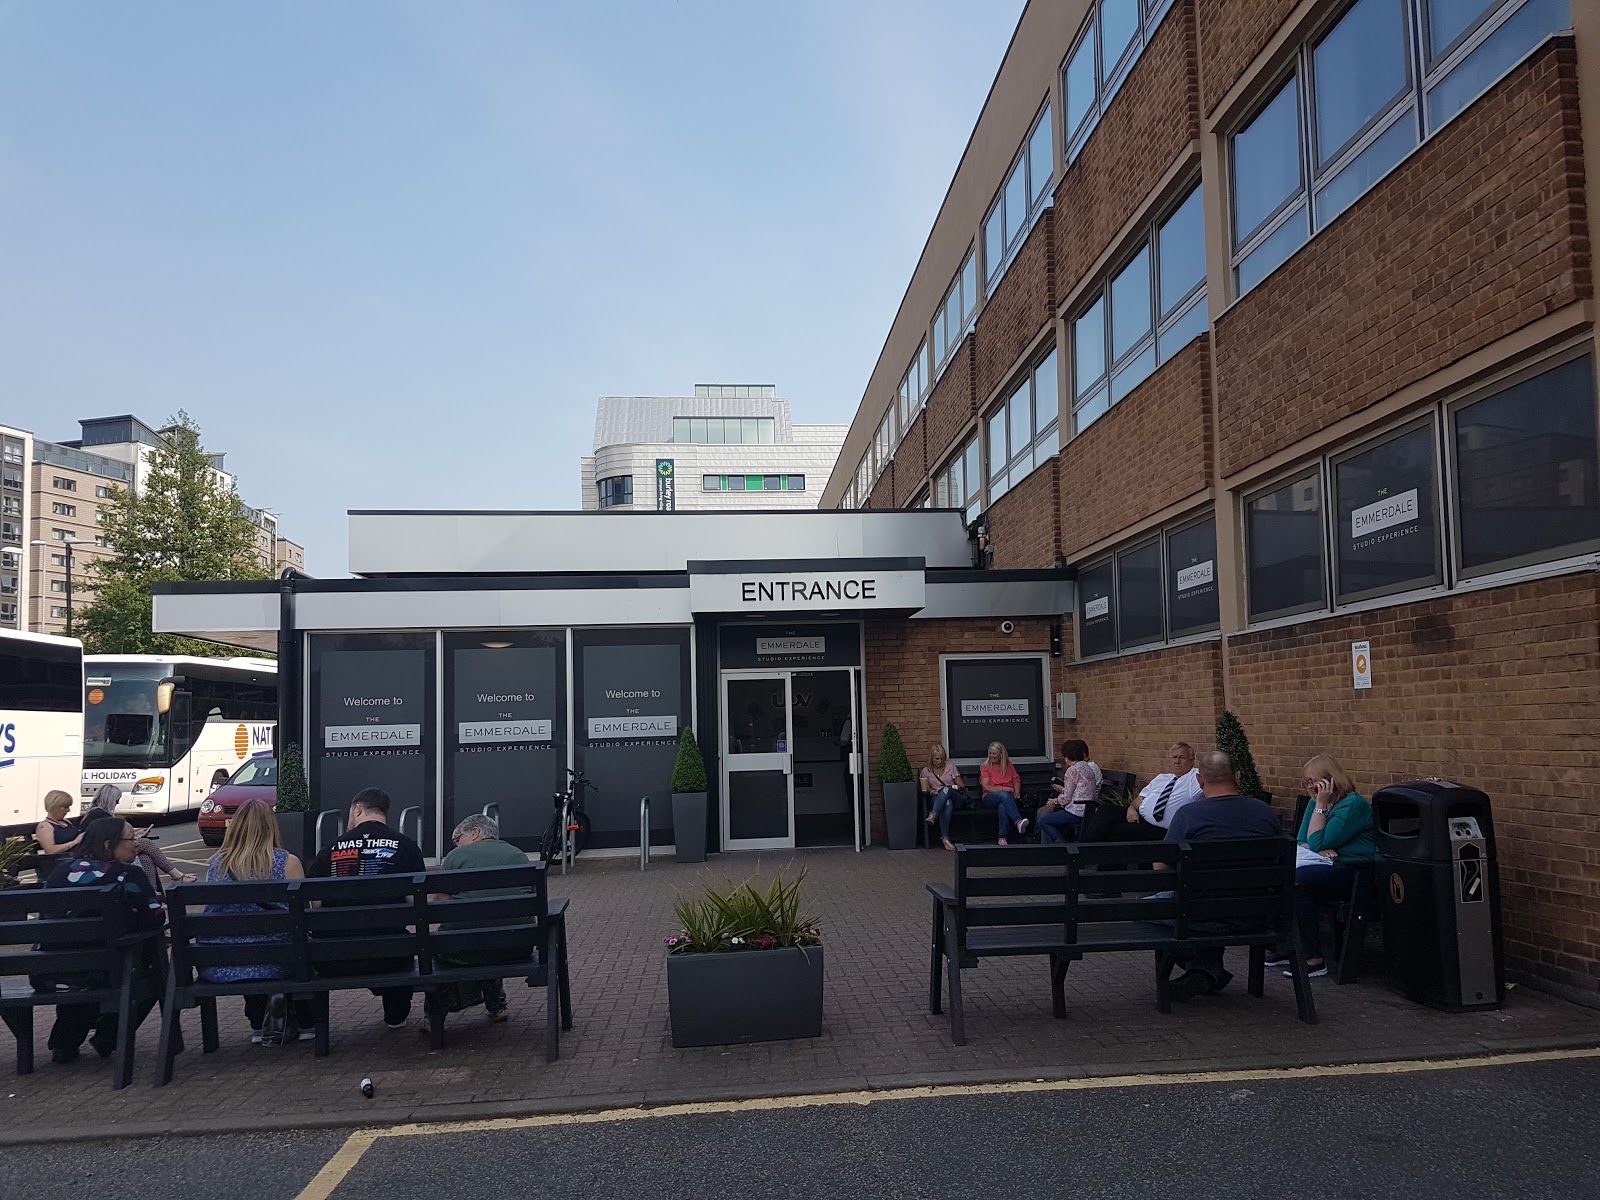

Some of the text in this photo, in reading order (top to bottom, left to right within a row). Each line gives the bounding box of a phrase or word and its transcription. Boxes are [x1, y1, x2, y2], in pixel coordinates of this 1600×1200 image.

[664, 478, 673, 499] burley
[1377, 488, 1388, 496] THE
[1356, 500, 1413, 529] EMMERDALE
[1353, 526, 1419, 550] STUDIO EXPERIENCE
[1179, 567, 1210, 585] EMMERDALE
[742, 580, 877, 602] ENTRANCE
[761, 642, 821, 650] EMMERDALE
[477, 693, 535, 703] Welcome to
[606, 690, 661, 699] Welcome to
[343, 696, 403, 706] Welcome to
[966, 704, 1025, 712] EMMERDALE
[465, 726, 546, 737] EMMERDALE
[595, 721, 672, 733] EMMERDALE
[332, 731, 414, 742] EMMERDALE
[91, 772, 137, 780] HOLIDAYS
[338, 840, 363, 850] WAS
[366, 839, 399, 849] THERE
